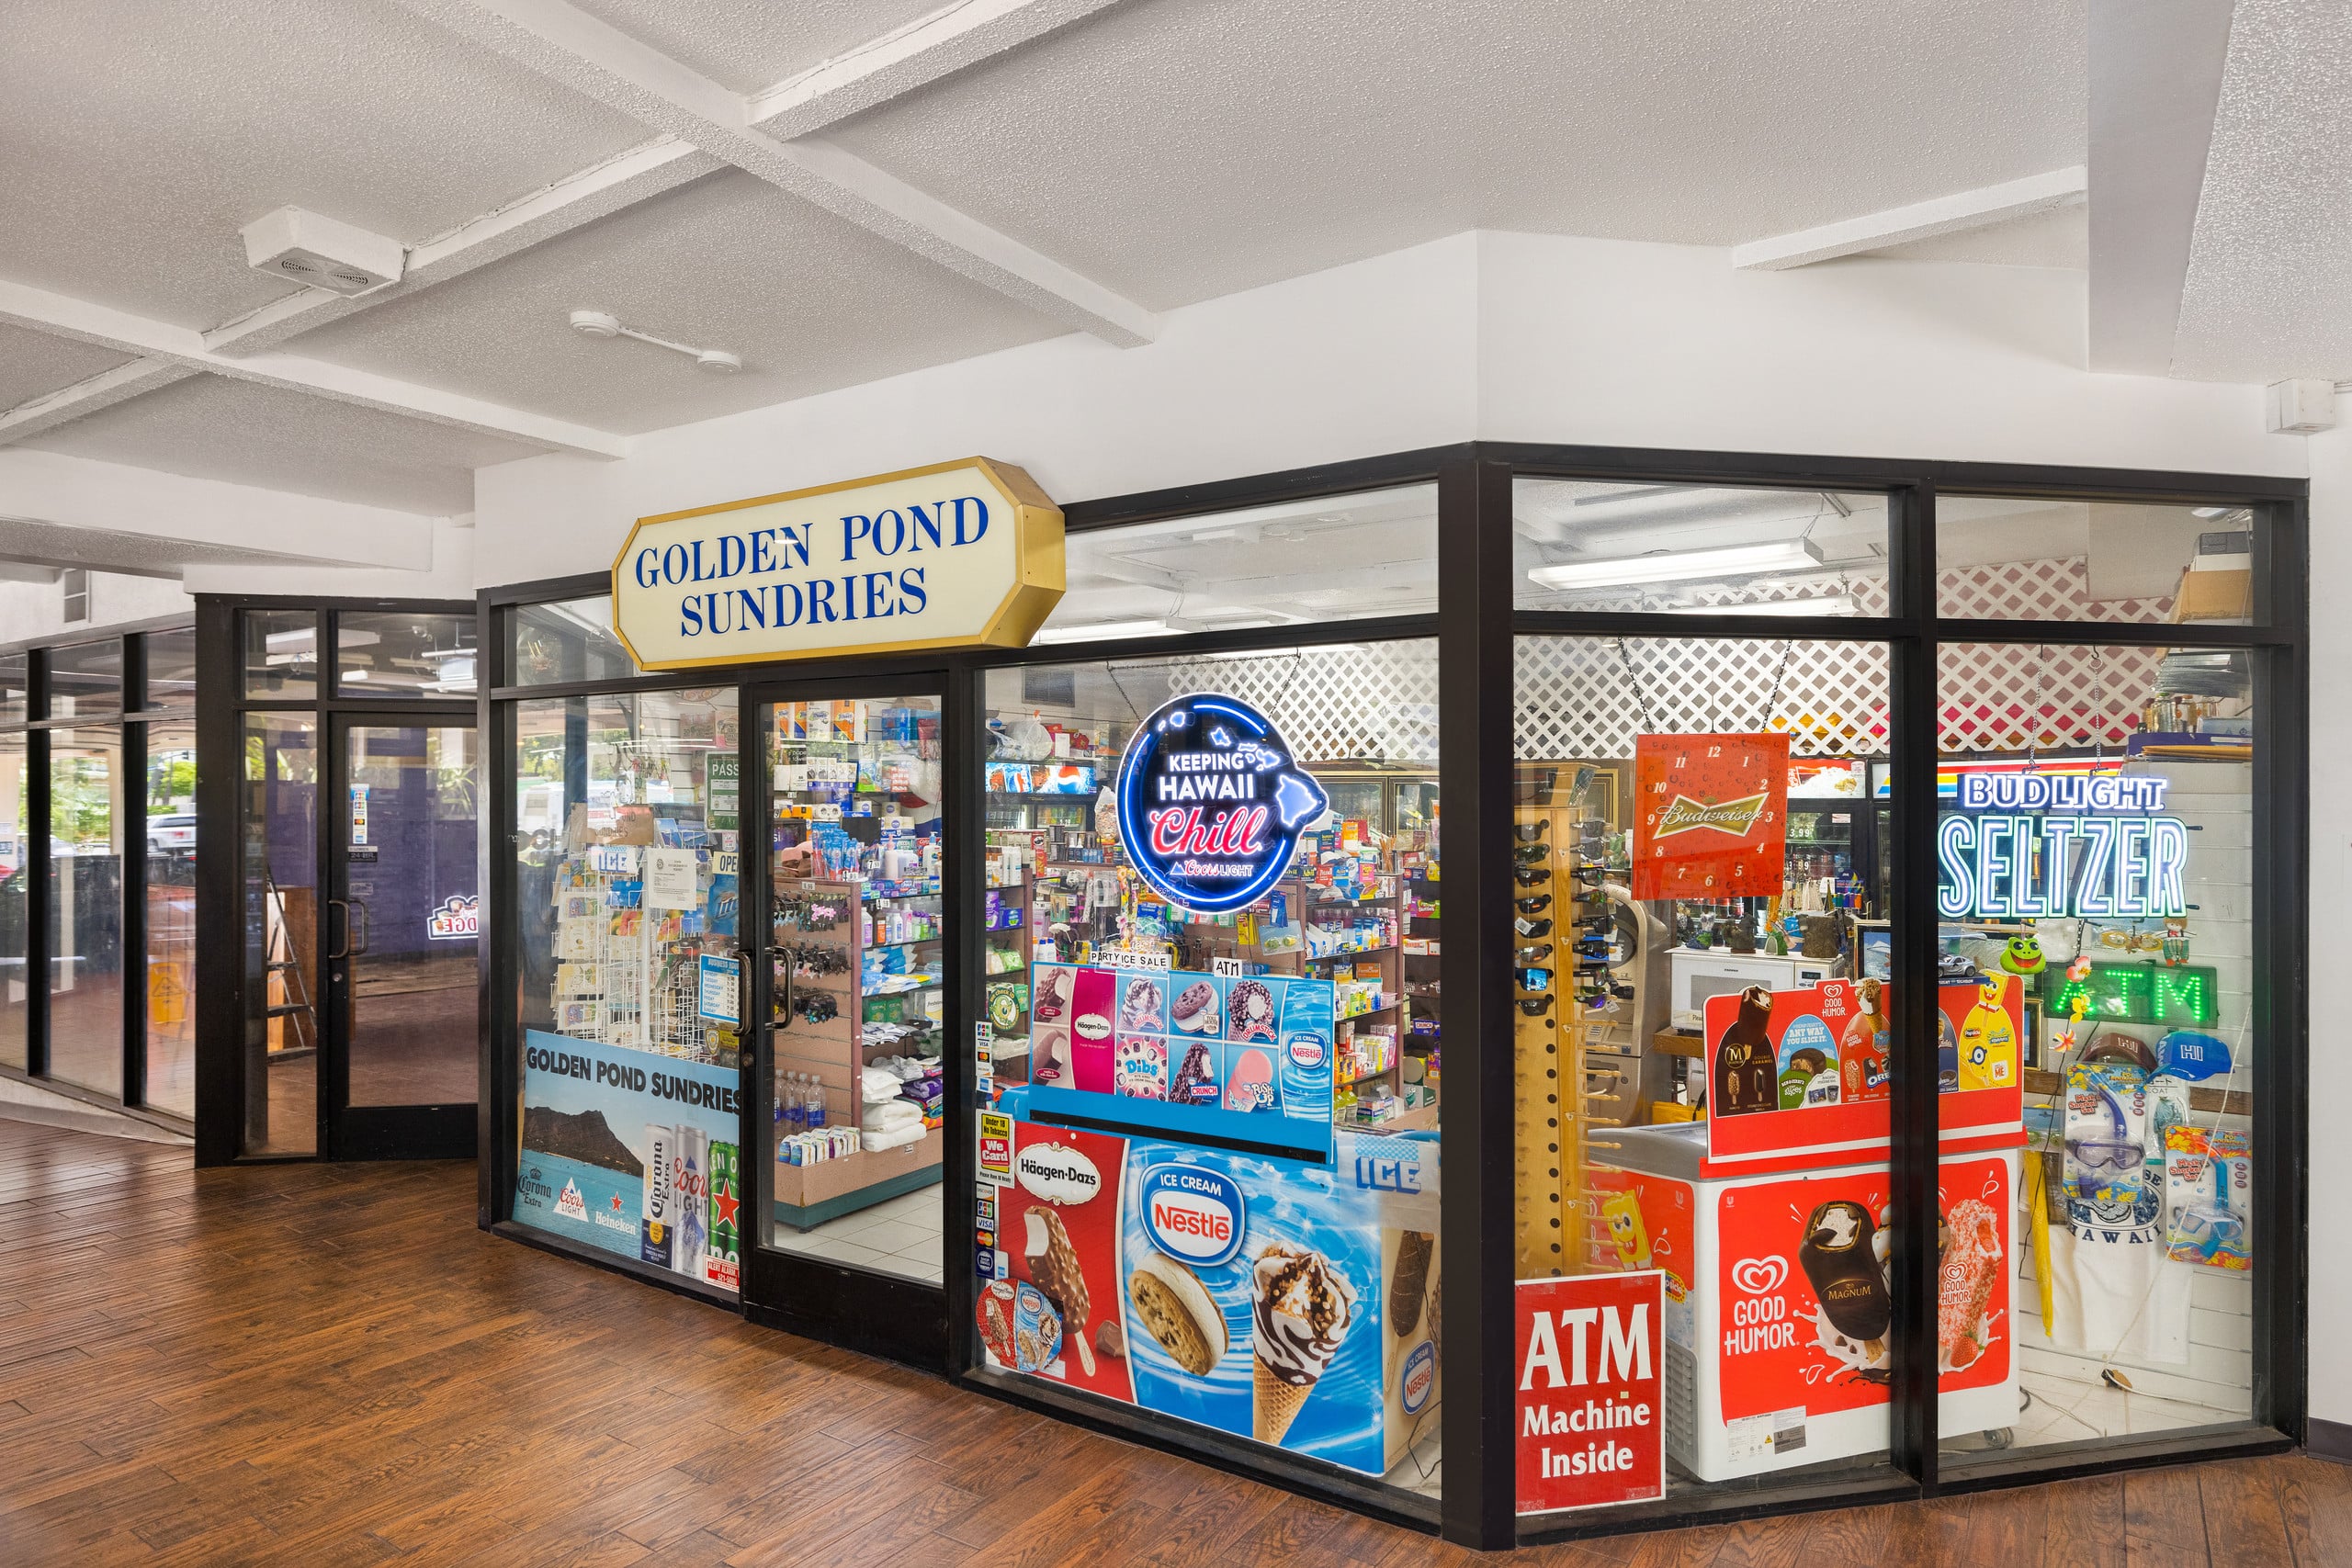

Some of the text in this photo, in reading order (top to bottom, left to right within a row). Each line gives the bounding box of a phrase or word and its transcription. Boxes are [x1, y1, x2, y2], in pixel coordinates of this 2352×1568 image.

[636, 496, 989, 589] GOLDEN POND
[681, 567, 927, 637] SUNDRIES
[1707, 746, 1721, 758] 12
[712, 763, 739, 776] PASS
[1170, 752, 1244, 772] KEEPING
[1675, 757, 1687, 769] 11
[1743, 756, 1749, 768] 1
[1159, 774, 1254, 800] HAWAII
[1654, 782, 1667, 794] 10
[1759, 779, 1769, 791] 2
[1963, 773, 2167, 811] BUD LIGHT
[1647, 814, 1655, 826] 9
[1656, 805, 1762, 825] Budweiser
[1765, 811, 1773, 822] 3
[1150, 807, 1267, 854] Chill
[1656, 846, 1664, 857] 8
[1757, 843, 1765, 854] 4
[720, 855, 739, 873] OPE
[1184, 860, 1253, 877] Coors LIGHT
[1736, 866, 1743, 877] 5
[1938, 815, 2188, 918] SELTZER
[1678, 868, 1686, 879] 7
[1705, 875, 1713, 886] 6
[1091, 952, 1167, 967] PARTY ICE SALE
[1216, 961, 1239, 976] ATM
[1825, 998, 1842, 1008] GOOD
[2057, 971, 2200, 1021] ATM
[1822, 1007, 1845, 1017] HUMOR
[1133, 1013, 1164, 1032] DRUMSTICK
[1242, 1024, 1277, 1042] DRUMSTICK
[1789, 1027, 1824, 1038] ANY WAY
[1801, 1036, 1817, 1044] SLICE
[2180, 1044, 2203, 1062] HI
[1125, 1059, 1159, 1077] Dibs
[1995, 1066, 2005, 1077] ME
[526, 1046, 742, 1115] GOLDEN POND SUNDRIES
[1867, 1072, 1891, 1087] ORE
[1192, 1087, 1217, 1096] CRUNCH
[1256, 1092, 1273, 1106] UP
[2075, 1094, 2095, 1103] Mask
[2068, 1100, 2098, 1111] Snorkel
[2081, 1106, 2095, 1114] Set
[986, 1117, 1006, 1128] Under 18
[989, 1127, 1007, 1137] Tobacco
[986, 1140, 1004, 1151] We
[982, 1150, 1008, 1162] Card
[2177, 1159, 2199, 1168] Mask
[650, 1141, 670, 1219] Corona Extra
[673, 1156, 708, 1200] Coor
[1355, 1156, 1422, 1193] ICE
[518, 1175, 551, 1199] Corona
[1160, 1173, 1222, 1197] ICE CREAM
[523, 1194, 542, 1208] Extra
[560, 1188, 585, 1208] Coors
[674, 1190, 707, 1217] LIGHT
[561, 1205, 581, 1216] LIGHT
[595, 1211, 637, 1235] Heineken
[978, 1219, 992, 1228] VISA
[1828, 1285, 1871, 1301] MAGNUM
[1945, 1280, 1965, 1292] GOOD
[1941, 1291, 1971, 1304] HUMOR
[1734, 1295, 1785, 1326] GOOD
[1724, 1322, 1795, 1356] HUMOR
[1415, 1347, 1429, 1362] CREAM
[1519, 1303, 1654, 1391] ATM
[1522, 1398, 1650, 1437] Machine
[1542, 1440, 1634, 1479] Inside
